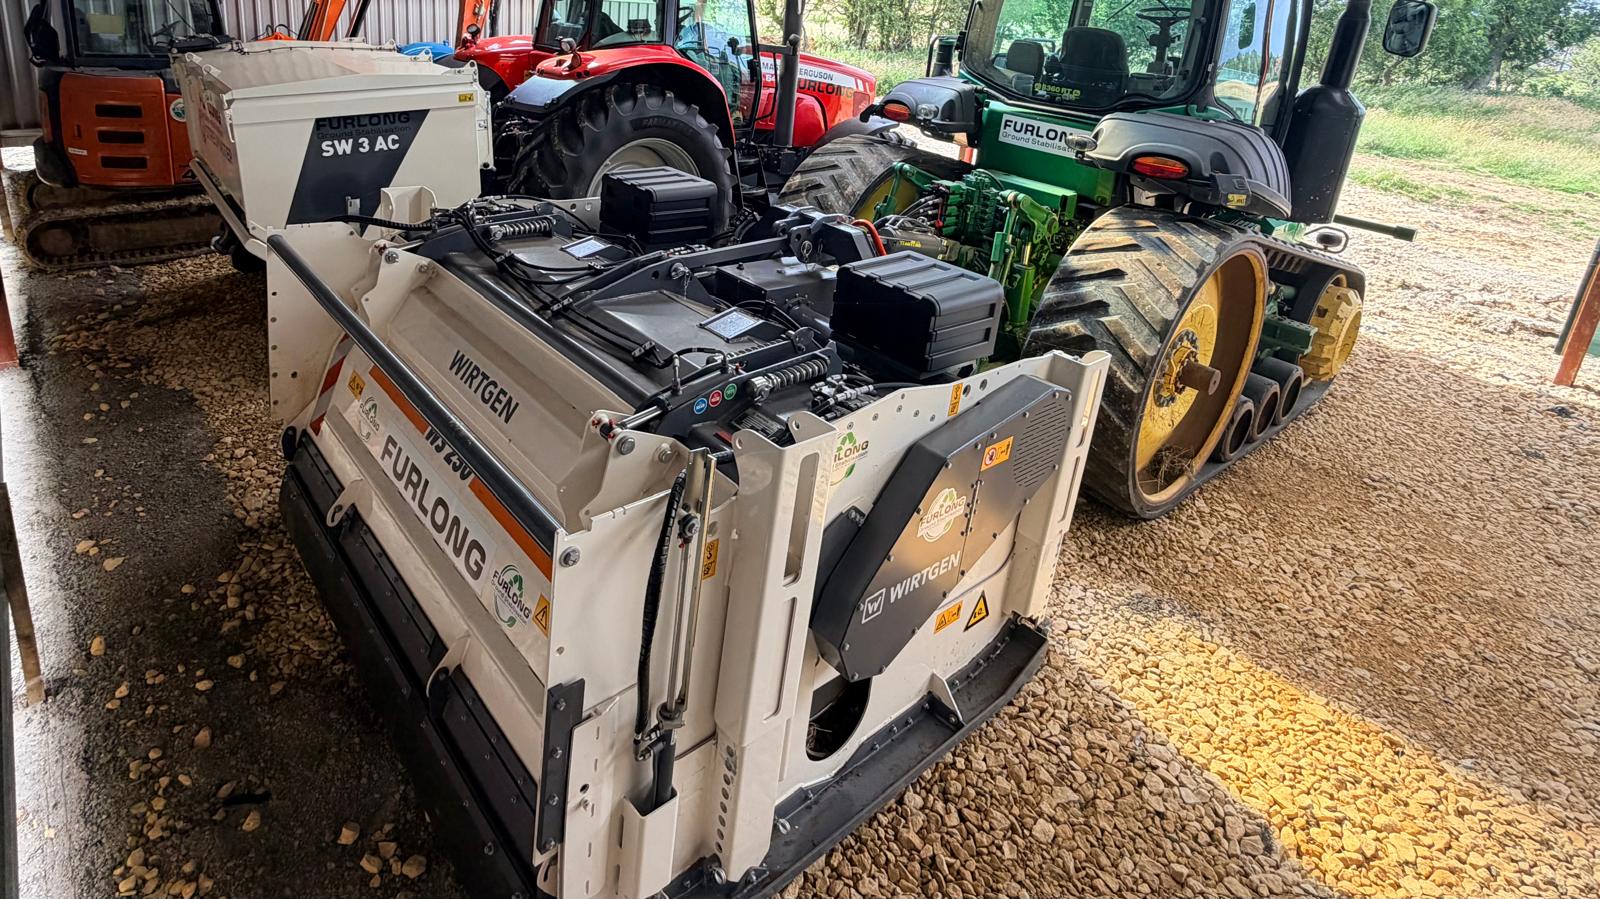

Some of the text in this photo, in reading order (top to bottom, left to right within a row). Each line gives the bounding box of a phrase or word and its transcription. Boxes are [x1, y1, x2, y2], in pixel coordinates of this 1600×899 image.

[799, 67, 834, 81] ERGUSON
[797, 78, 854, 99] URLONG
[315, 112, 411, 131] FURLONG
[1003, 119, 1073, 142] FURLON
[316, 130, 353, 140] Ground
[321, 134, 400, 157] SW 3 AC
[1001, 131, 1077, 154] Ground Stabilisati
[448, 349, 520, 424] WIRTGEN
[380, 434, 487, 581] FURLONG
[920, 497, 966, 528] FURLONG
[890, 550, 961, 604] WIRTGEN
[492, 570, 531, 619] FURLONG
